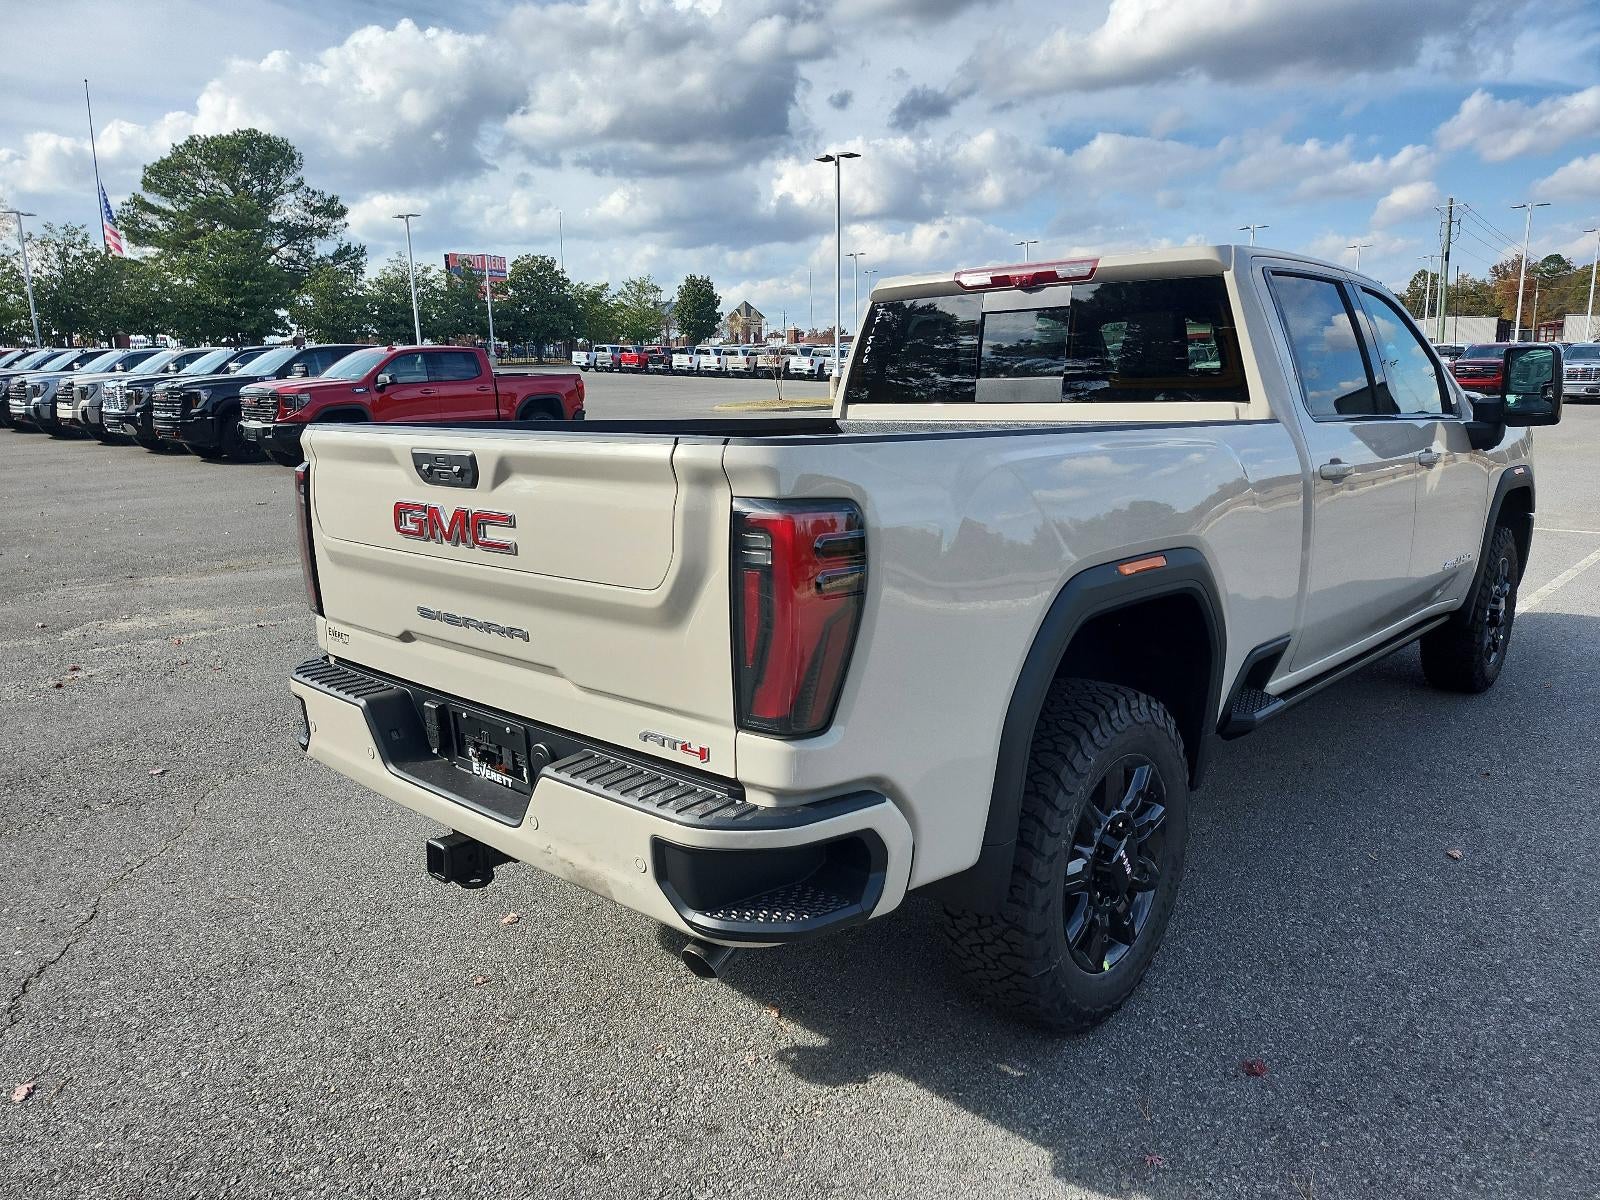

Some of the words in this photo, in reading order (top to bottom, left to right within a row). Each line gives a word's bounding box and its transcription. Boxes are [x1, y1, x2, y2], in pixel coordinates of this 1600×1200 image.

[393, 499, 519, 556] GMC
[328, 626, 350, 642] EVERETT
[417, 605, 530, 643] SIERRA
[639, 730, 710, 763] AT4
[473, 761, 513, 788] EVERETT
